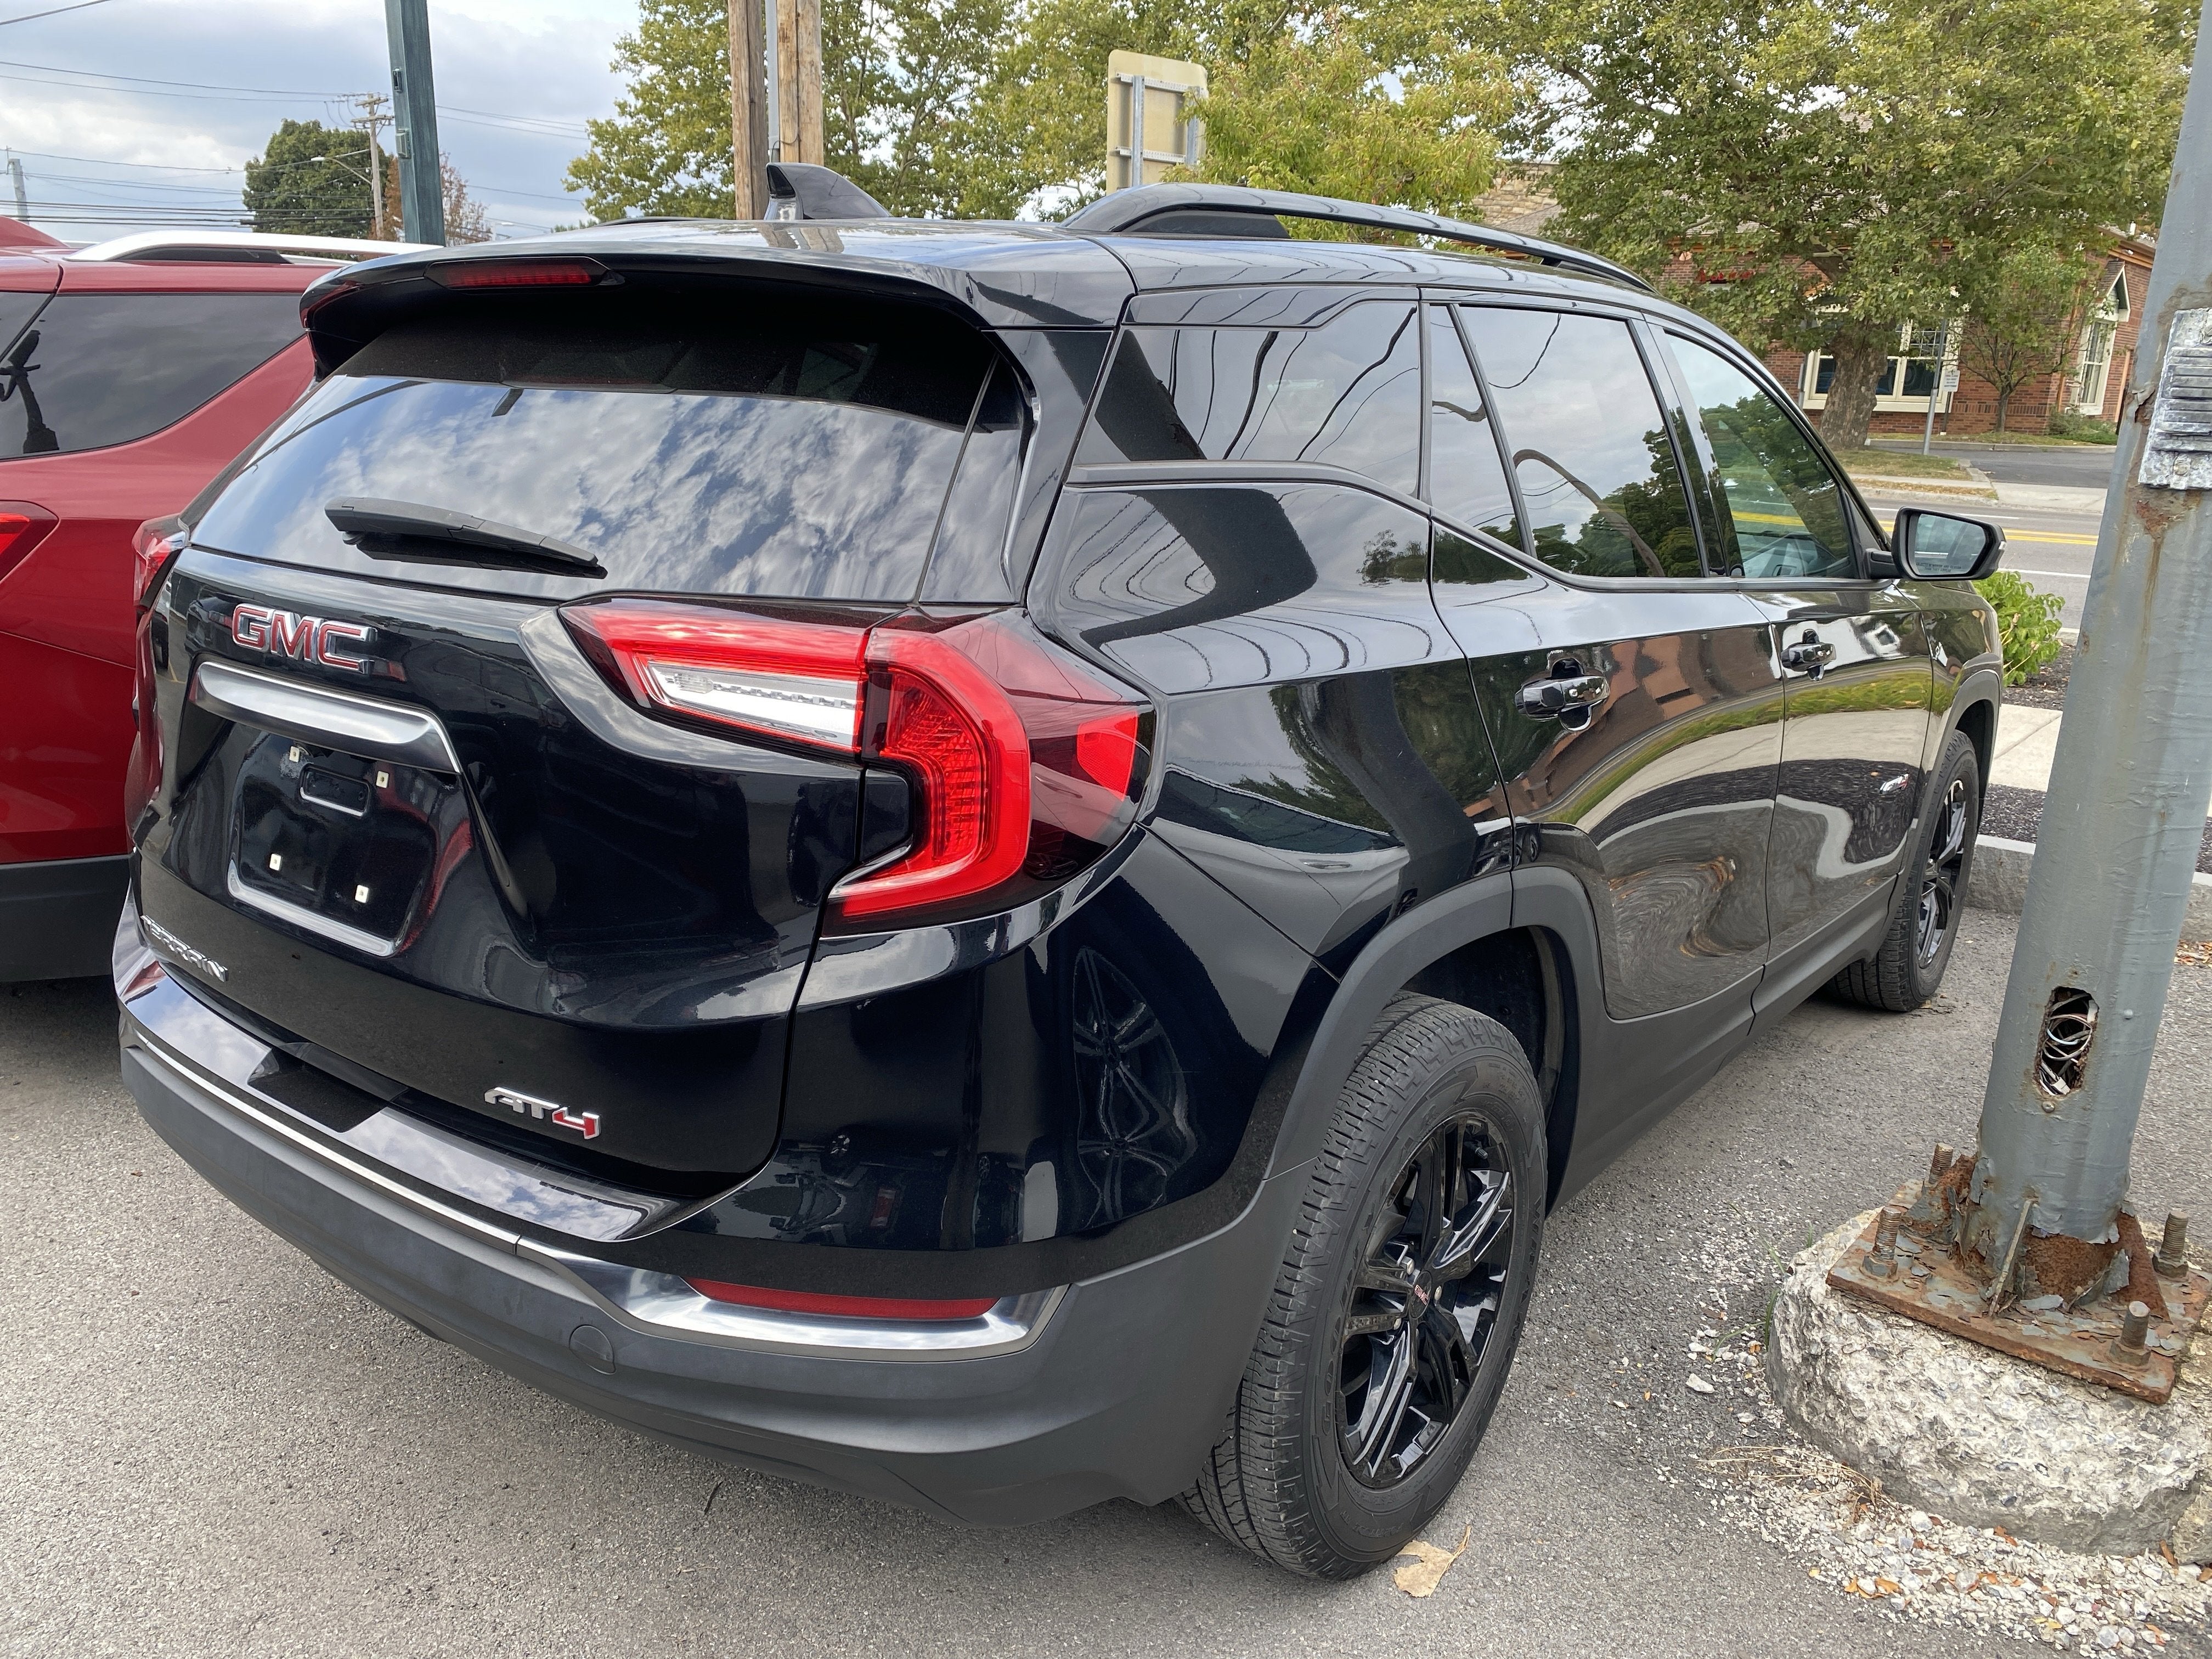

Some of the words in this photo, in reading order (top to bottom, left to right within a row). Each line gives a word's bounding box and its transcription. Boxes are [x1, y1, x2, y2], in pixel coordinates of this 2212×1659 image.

[232, 603, 377, 674] GMC
[140, 915, 228, 983] TERRAIN
[484, 1087, 602, 1139] AT4
[1414, 1284, 1429, 1305] GMC
